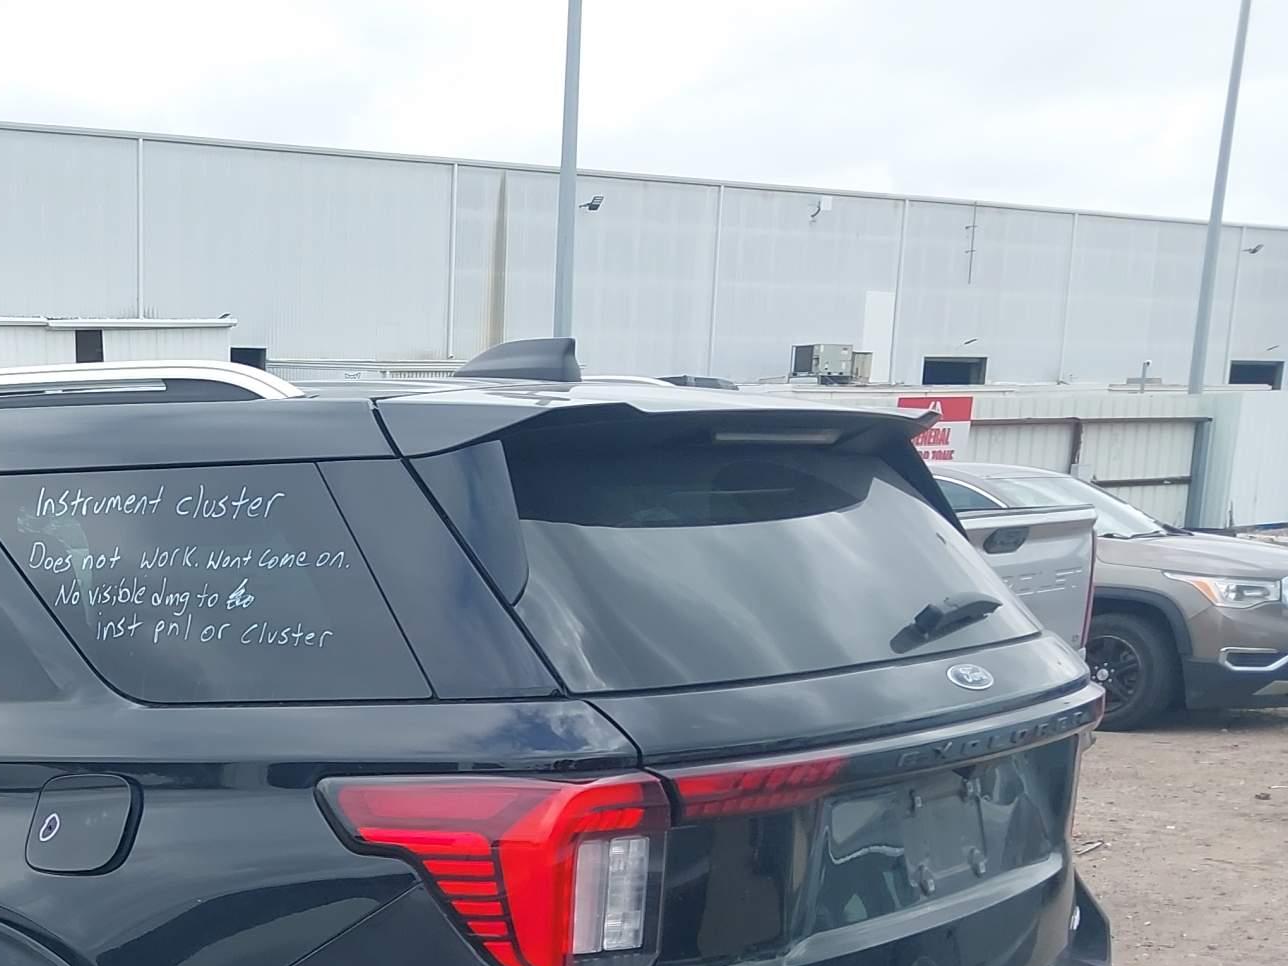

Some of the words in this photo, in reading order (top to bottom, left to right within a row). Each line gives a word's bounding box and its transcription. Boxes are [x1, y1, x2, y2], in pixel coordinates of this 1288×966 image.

[36, 486, 164, 517] Instrument
[29, 542, 71, 573] Does
[82, 547, 121, 569] not
[316, 552, 350, 569] on.
[55, 579, 80, 607] No
[88, 577, 147, 607] visible
[151, 577, 190, 616] dmg
[196, 583, 218, 607] to
[153, 613, 192, 644] pnl
[200, 623, 231, 642] or
